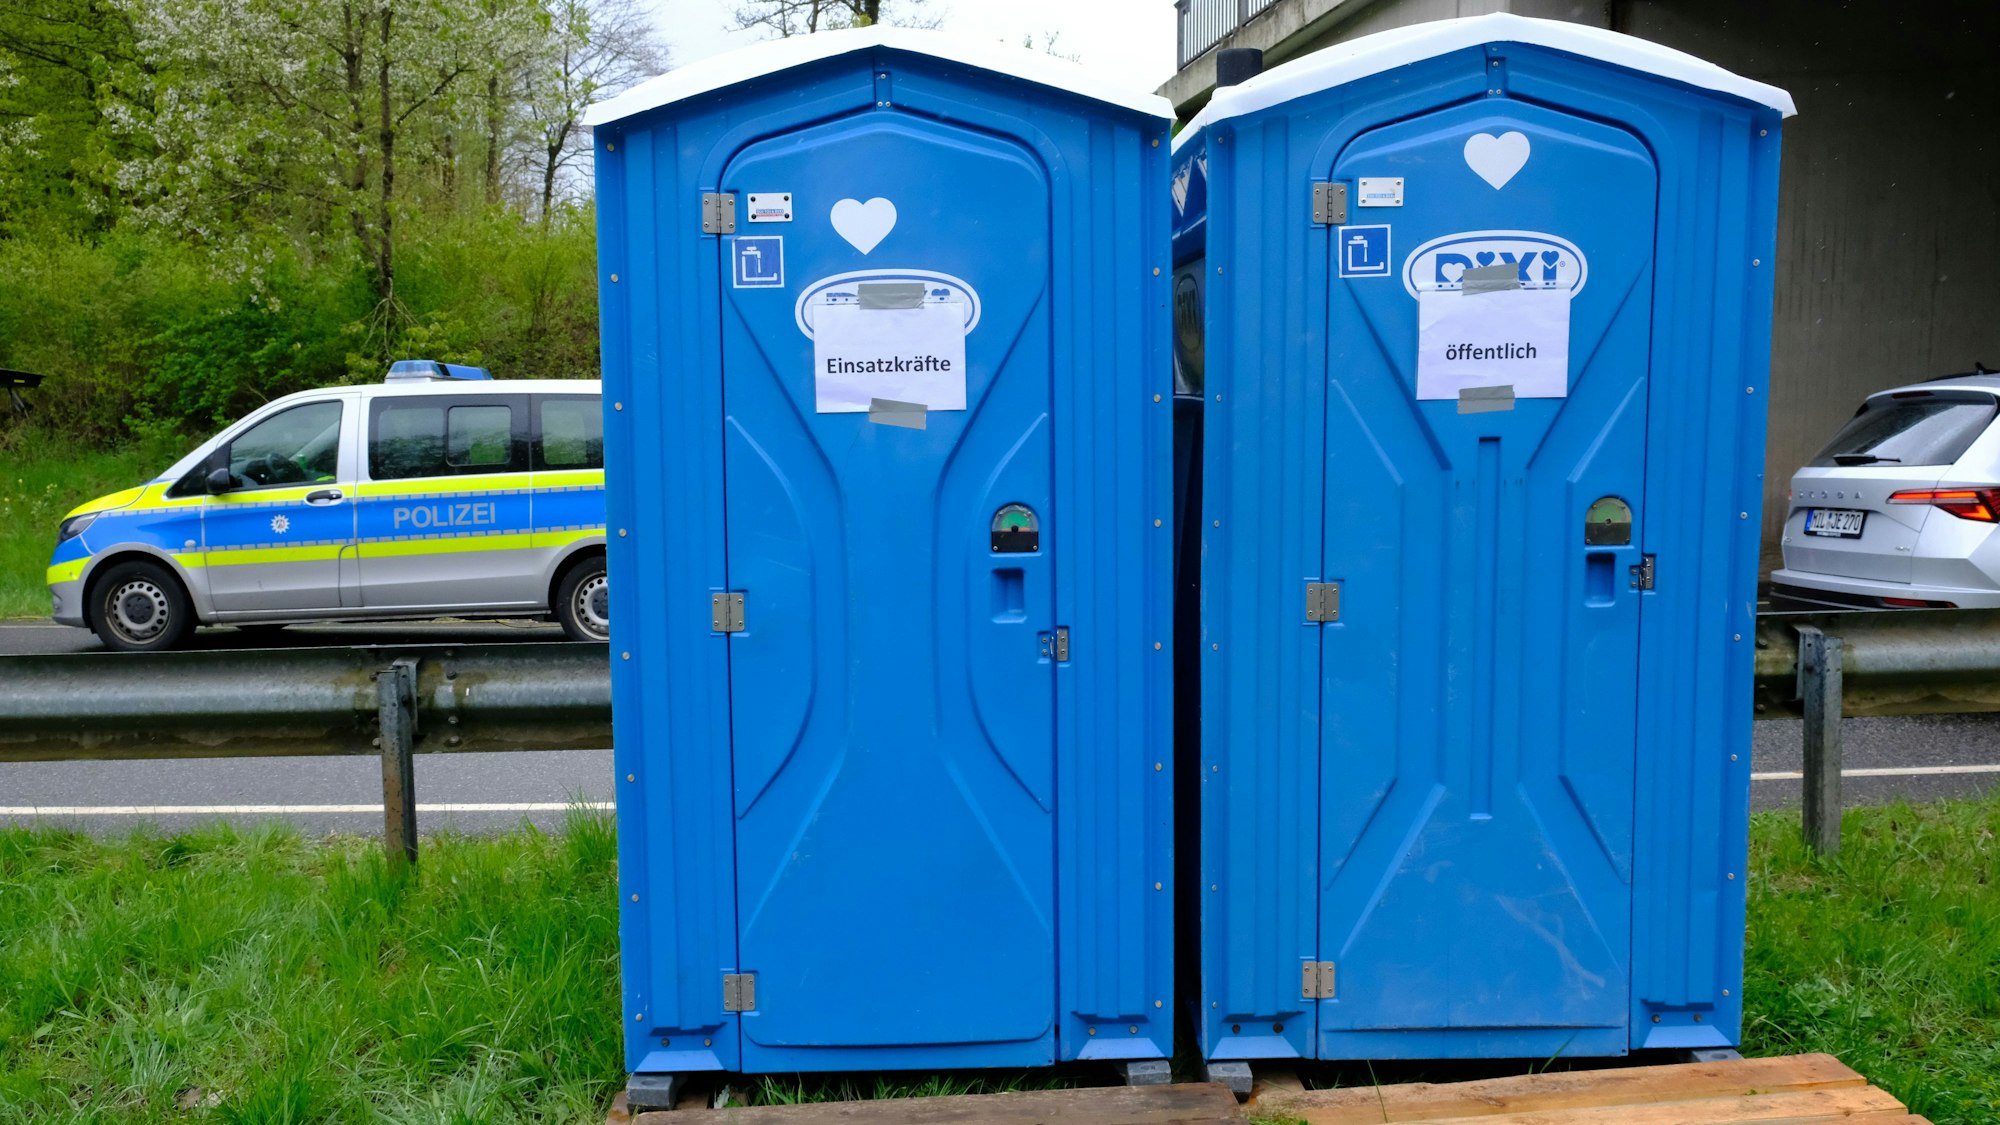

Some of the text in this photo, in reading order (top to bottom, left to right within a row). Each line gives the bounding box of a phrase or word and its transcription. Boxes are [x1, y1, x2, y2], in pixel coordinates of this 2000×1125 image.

[1445, 342, 1537, 361] öffentlich
[826, 354, 951, 374] Einsatzkräfte
[393, 502, 496, 529] POLIZEI
[1843, 514, 1861, 532] 270
